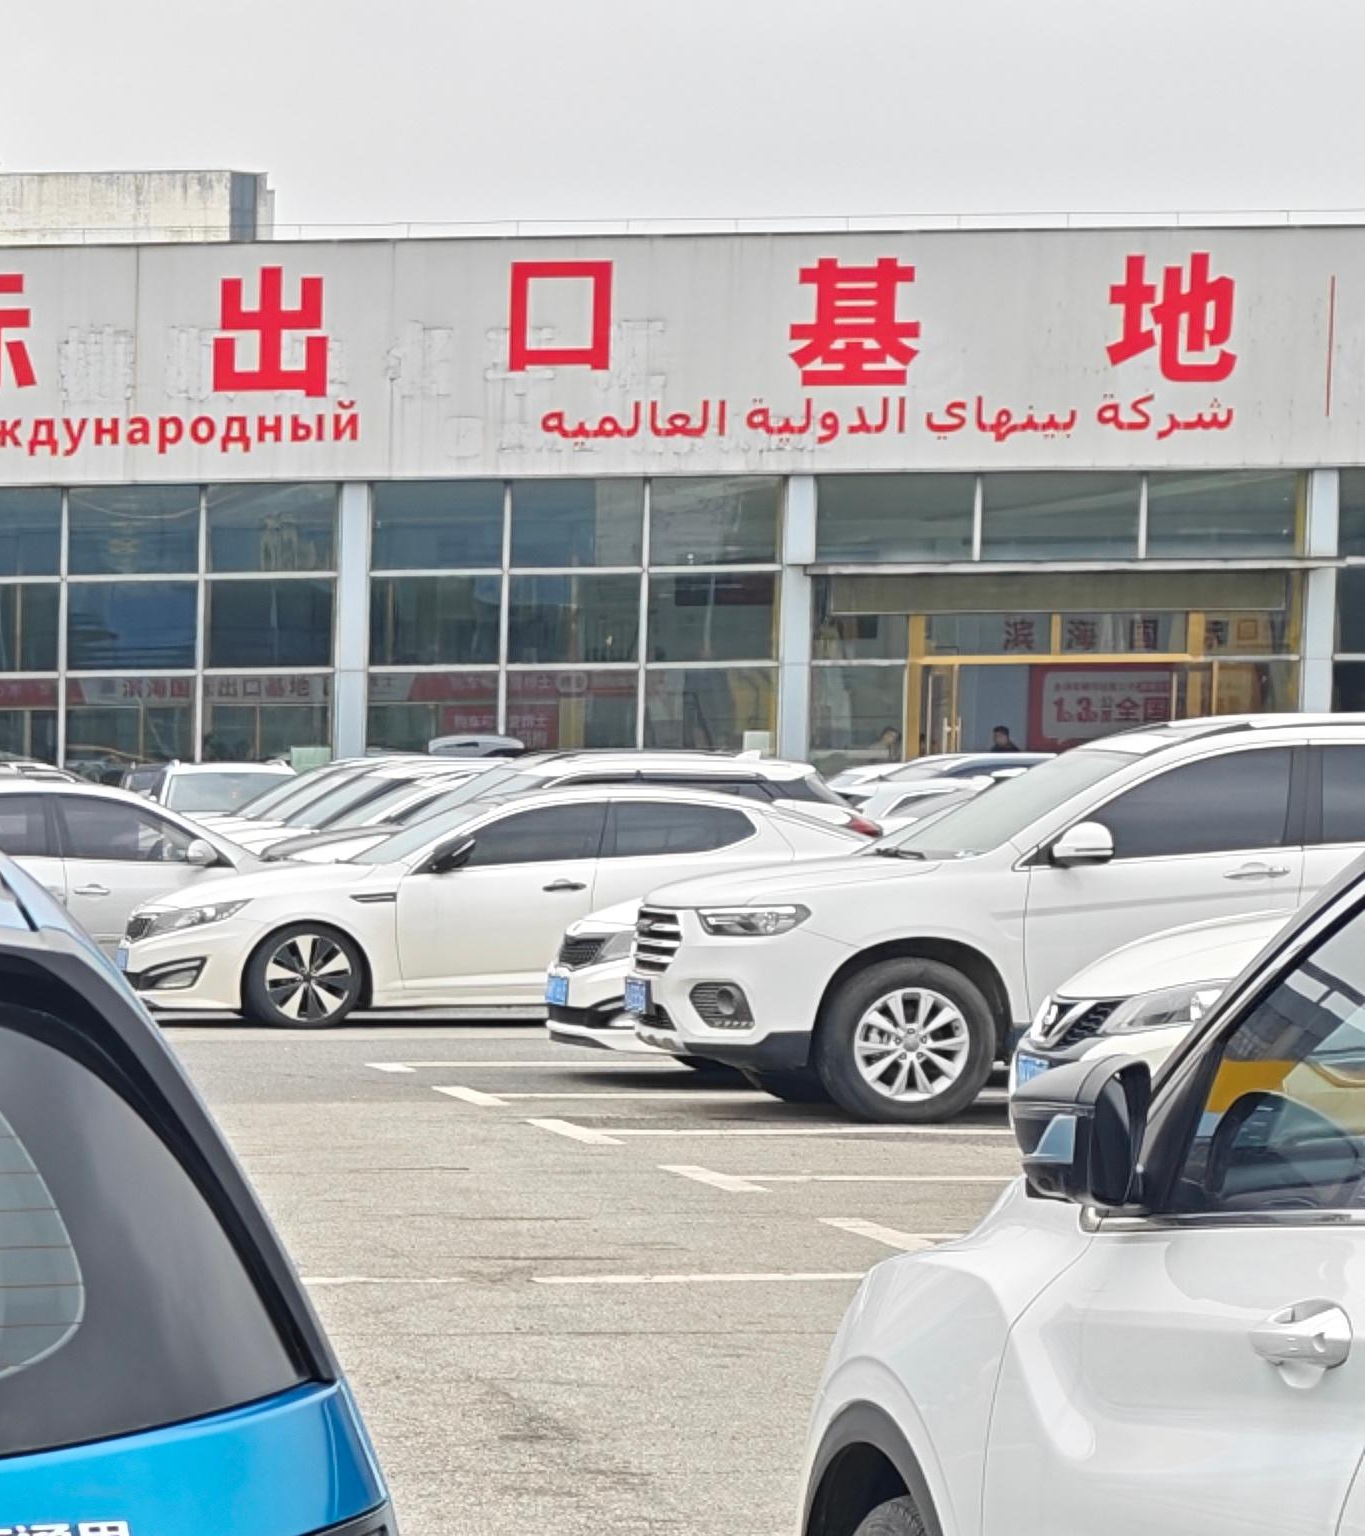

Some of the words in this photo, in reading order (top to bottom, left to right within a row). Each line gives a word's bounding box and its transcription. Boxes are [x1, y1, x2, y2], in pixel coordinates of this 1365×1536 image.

[745, 396, 906, 444] الدولية
[925, 395, 1078, 442] بينهاي
[1096, 392, 1235, 440] شركة
